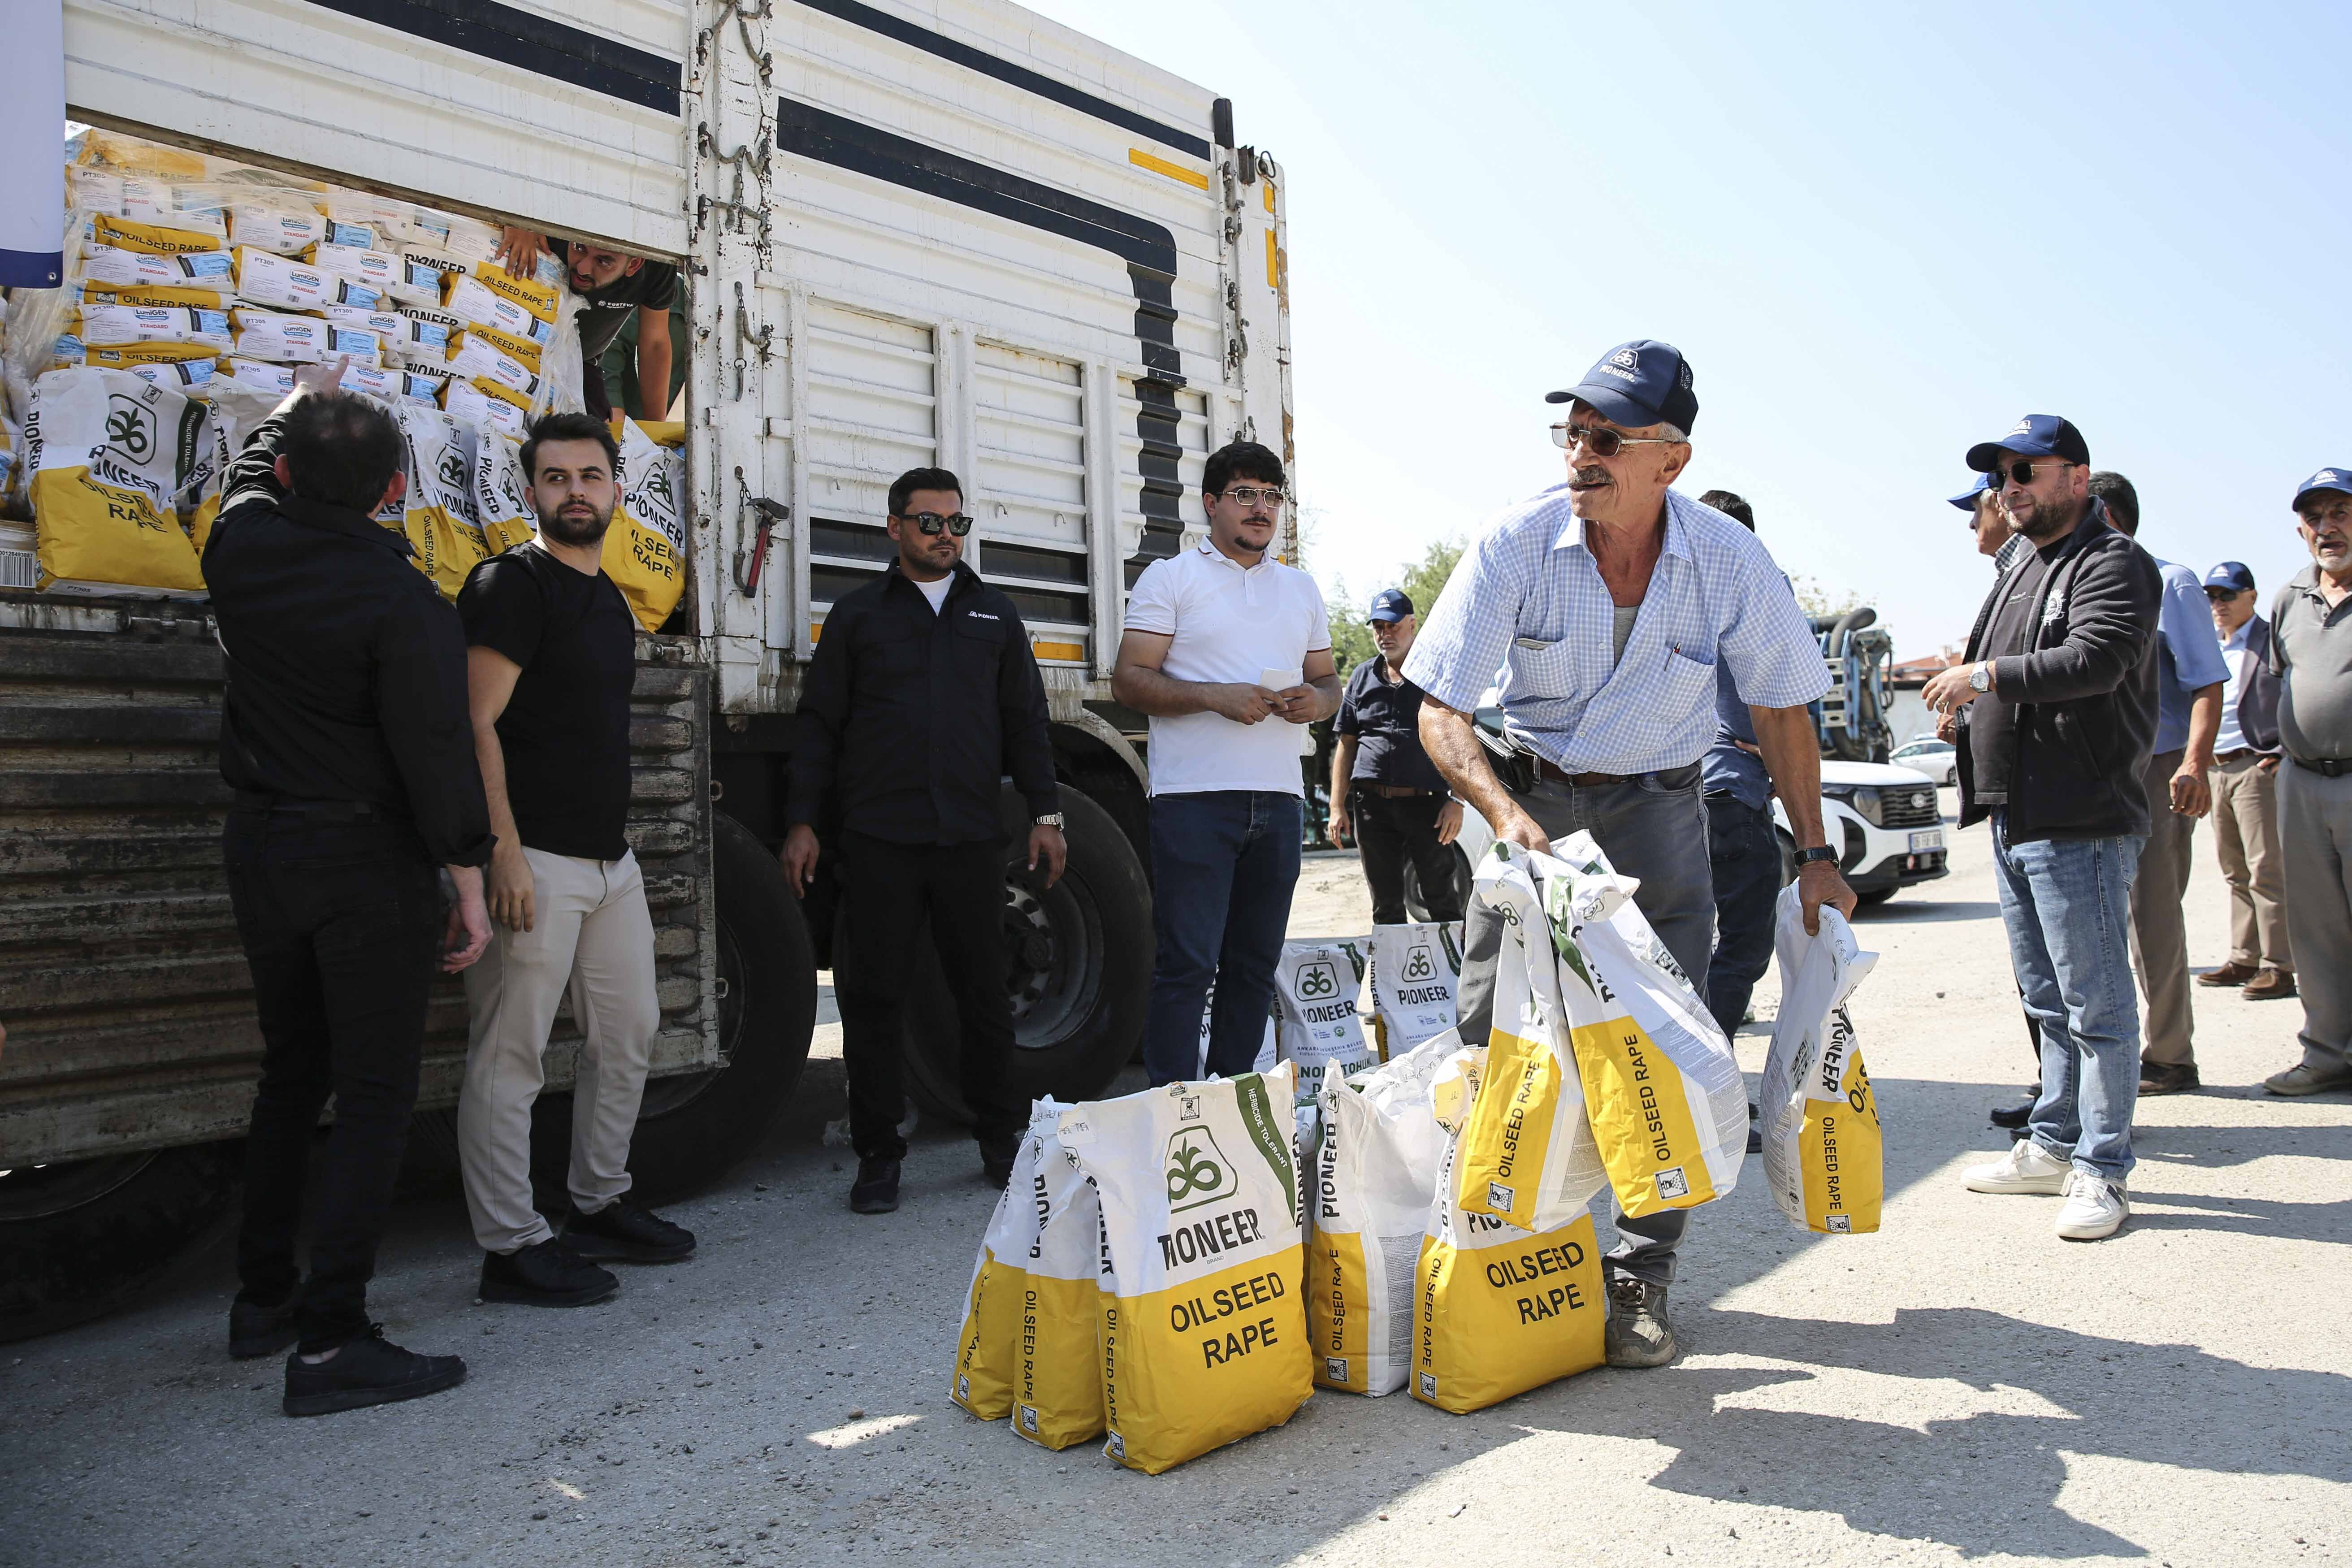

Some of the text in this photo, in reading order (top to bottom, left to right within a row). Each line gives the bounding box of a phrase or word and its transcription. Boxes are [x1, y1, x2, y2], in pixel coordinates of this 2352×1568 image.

[255, 257, 275, 266] PT305
[361, 255, 387, 265] LumiGEN
[139, 268, 169, 276] STANDARD
[291, 271, 320, 282] LumiGEN
[292, 285, 317, 295] STANDARD
[484, 276, 543, 306] OILSEED RAPE
[123, 295, 179, 308] OILSEED
[497, 300, 520, 315] LumiGEN
[370, 314, 395, 324] LumiGEN
[495, 312, 515, 325] STANDARD
[284, 325, 312, 334] LumiGEN
[471, 338, 488, 350] PT305
[498, 358, 521, 374] LumiGEN
[1599, 364, 1634, 382] PIONEER
[358, 378, 382, 388] STANDARD
[495, 369, 515, 384] STANDARD
[488, 399, 511, 411] LumiGEN
[624, 492, 683, 549] PIONEER
[423, 515, 434, 576] OILSEED RAPE
[633, 544, 674, 581] RAPE
[1397, 986, 1451, 1005] PIONEER
[1624, 1034, 1671, 1161] OILSEED RAPE
[1247, 1087, 1288, 1169] HERBICIDE TOLERANT
[1499, 1060, 1540, 1178] OILSEED RAPE
[1823, 1117, 1842, 1210] OILSEED RAPE
[1206, 1255, 1224, 1265] BRAND
[1486, 1242, 1584, 1288] OILSEED
[1171, 1272, 1285, 1332] OILSEED
[1516, 1283, 1585, 1325] RAPE
[1332, 1291, 1345, 1351] OILSEED
[1422, 1258, 1442, 1368] OILSEED RAPE
[1023, 1290, 1037, 1401] OILSEED RAPE
[1202, 1317, 1278, 1369] RAPE
[1107, 1382, 1118, 1427] RAPE
